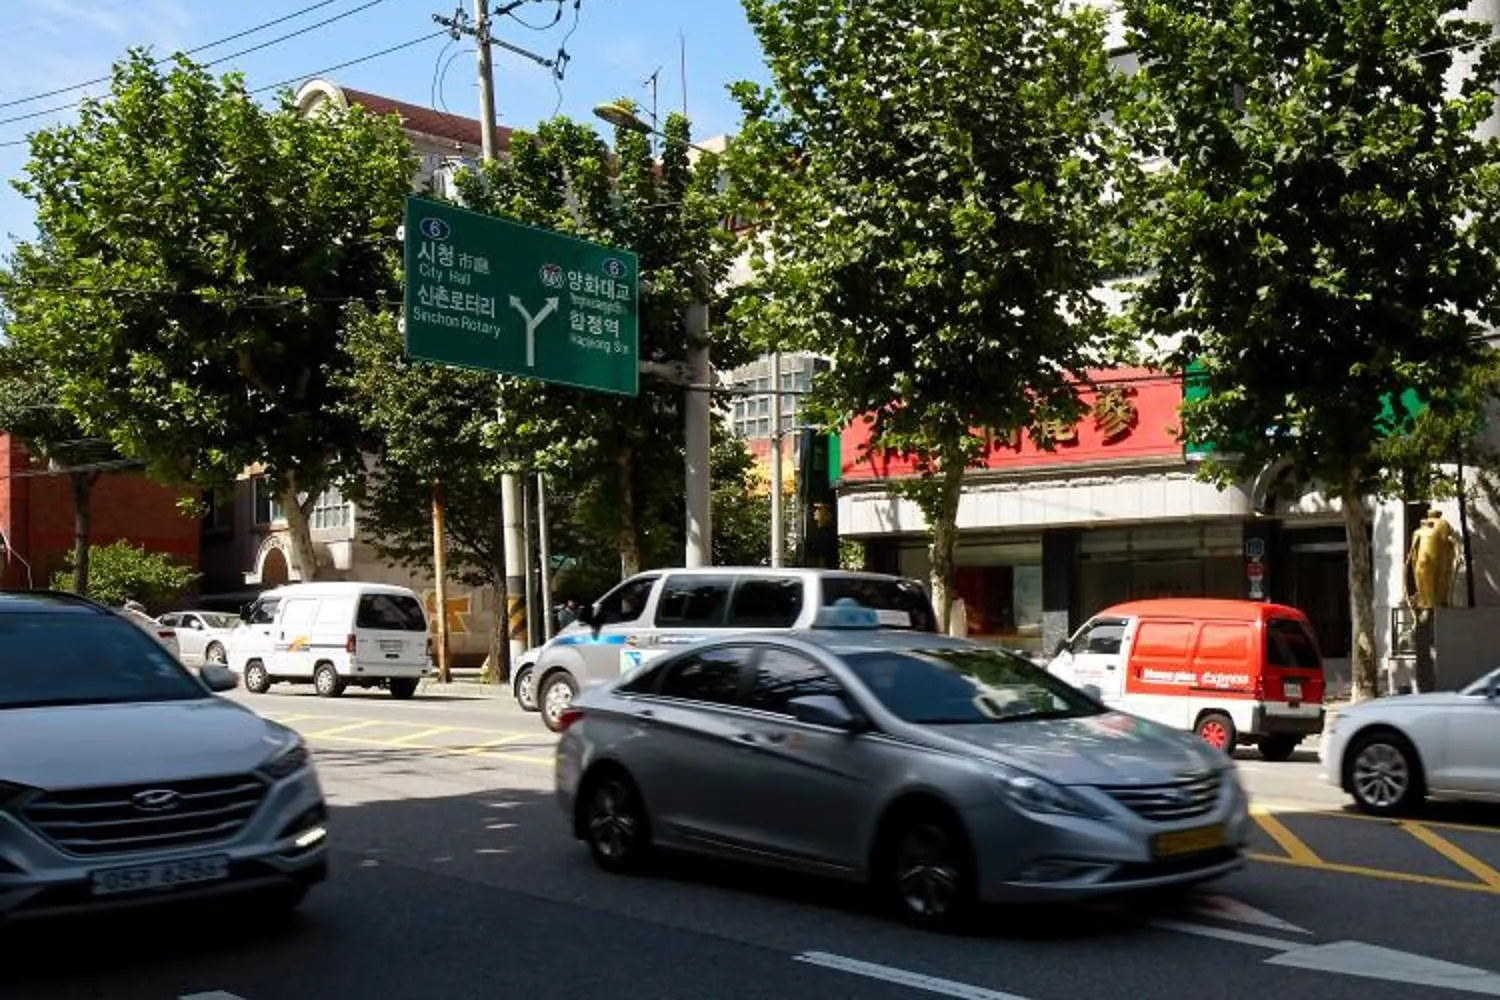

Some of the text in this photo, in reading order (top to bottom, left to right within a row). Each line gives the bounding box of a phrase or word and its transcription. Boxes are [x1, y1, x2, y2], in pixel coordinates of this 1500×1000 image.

[429, 220, 442, 237] 6
[417, 241, 454, 267] 시청
[419, 263, 471, 285] City Hall
[609, 261, 619, 275] 6
[567, 270, 631, 301] 양화대교
[417, 283, 495, 319] 신촌로터리
[413, 305, 501, 339] Sinchon Rotary
[569, 309, 619, 338] 합정역
